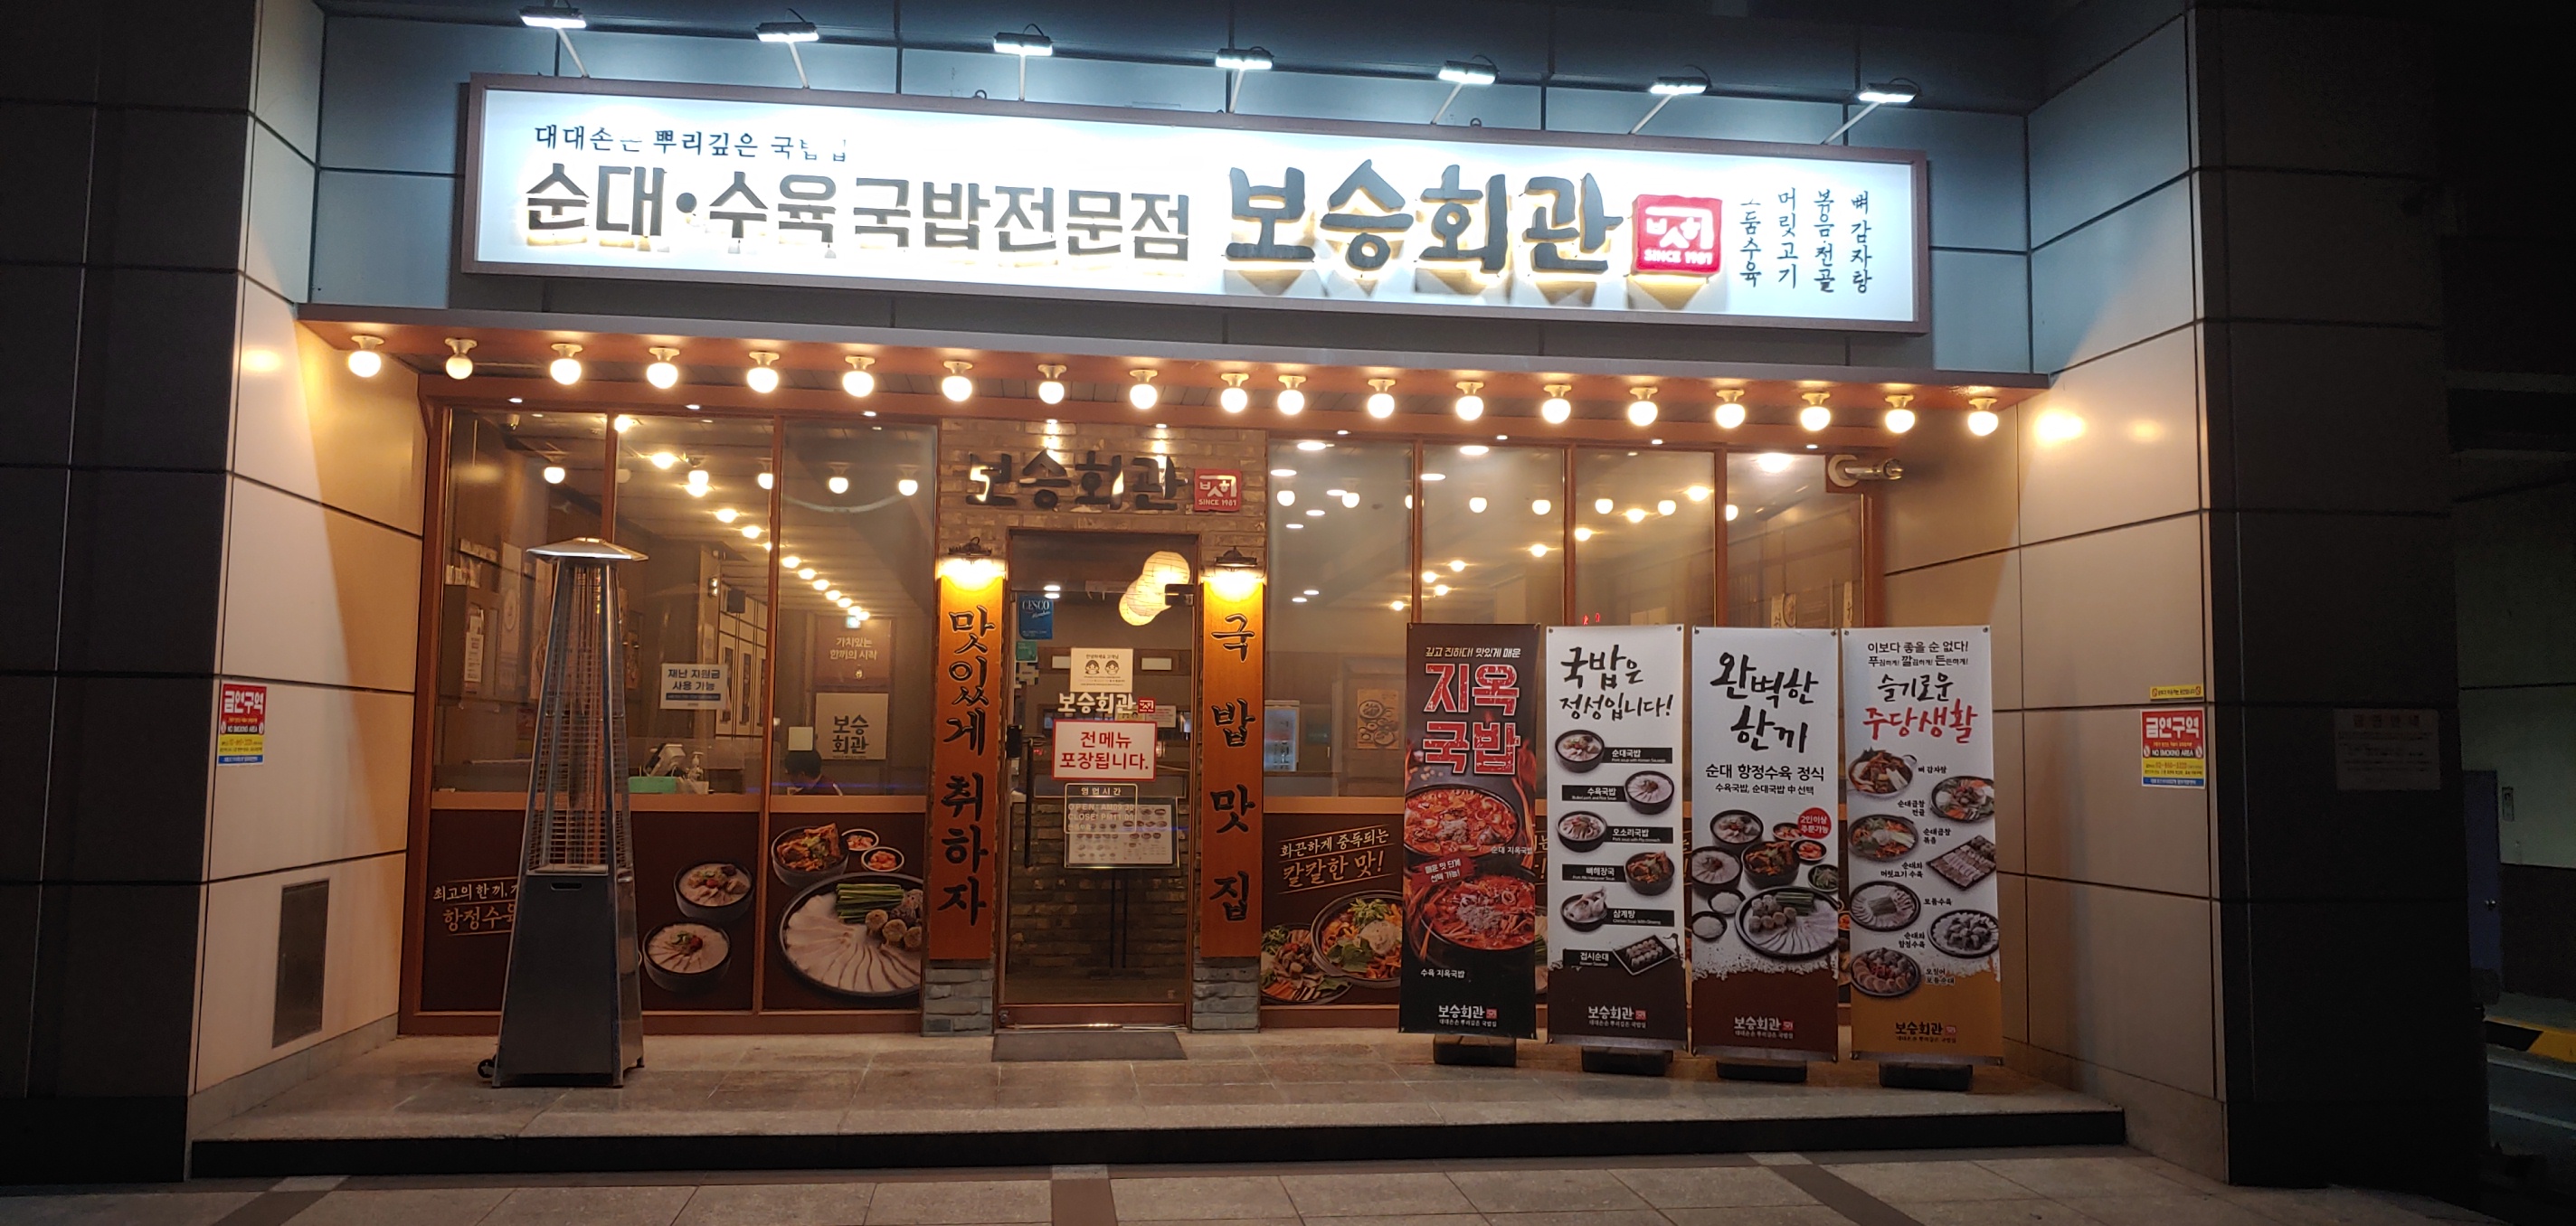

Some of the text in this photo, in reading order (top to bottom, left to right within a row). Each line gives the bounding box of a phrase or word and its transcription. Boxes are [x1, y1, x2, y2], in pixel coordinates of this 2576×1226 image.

[652, 129, 759, 157] 뿌리깊은
[1226, 159, 1624, 274] 보승회관
[1776, 187, 1799, 289] 머릿고기
[1643, 249, 1681, 263] SINCE
[965, 448, 1189, 511] 보승회관
[1022, 599, 1050, 610] CESCO
[1425, 646, 1521, 658] 깊고 진하다! 맛있게 매운
[1868, 640, 1969, 654] 이보다 좋을 순 없다!
[1560, 644, 1644, 692] 국밥은
[1868, 655, 1900, 667] 푸짐하게!
[1935, 655, 1969, 666] 든든하게!
[668, 668, 721, 679] 재난 지원금
[1709, 651, 1819, 709] 완벽한
[672, 681, 715, 692] 사용 가능
[1423, 663, 1520, 716] 지옥
[1877, 672, 1954, 703] 슬기로운
[223, 690, 264, 715] 금연구역
[1057, 692, 1137, 714] 보승회관
[1558, 692, 1674, 721] 정성입니다!
[832, 714, 870, 735] 보승
[1730, 704, 1809, 754] 한끼
[1862, 698, 1978, 744] 주당생활
[2145, 716, 2200, 739] 금연구역
[831, 734, 870, 755] 회관
[1080, 731, 1132, 750] 전메뉴
[1422, 721, 1521, 776] 국밥
[1059, 751, 1149, 770] 포장됩니다.
[1611, 749, 1642, 758] 순대국밥
[2152, 749, 2159, 757] NO
[2181, 749, 2193, 757] AREA
[936, 605, 996, 927] 맛있게 취하자
[1705, 763, 1824, 781] 순대 항정수육 정식
[1586, 787, 1617, 797] 수육국밥
[1715, 783, 1750, 794] 수육국밥,
[1752, 784, 1785, 795] 순대국밥
[1797, 785, 1814, 796] 선택
[1612, 828, 1649, 838] 오소리국밥
[1279, 828, 1389, 858] 화끈하게 중독되는
[1491, 845, 1506, 854] 순대
[1283, 850, 1385, 888] 칼칼한 맛!
[1439, 862, 1446, 871] 맛
[1586, 866, 1615, 877] 뼈해장국
[433, 883, 471, 902] 최고의
[1613, 909, 1636, 920] 삼계탕
[1580, 951, 1609, 962] 접시순대
[1420, 968, 1465, 979] 수육 지옥국밥
[1438, 1004, 1485, 1019] 보승회관
[1587, 1005, 1634, 1021] 보승회관
[1733, 1015, 1782, 1031] 보승회관
[1895, 1021, 1943, 1036] 보승회관
